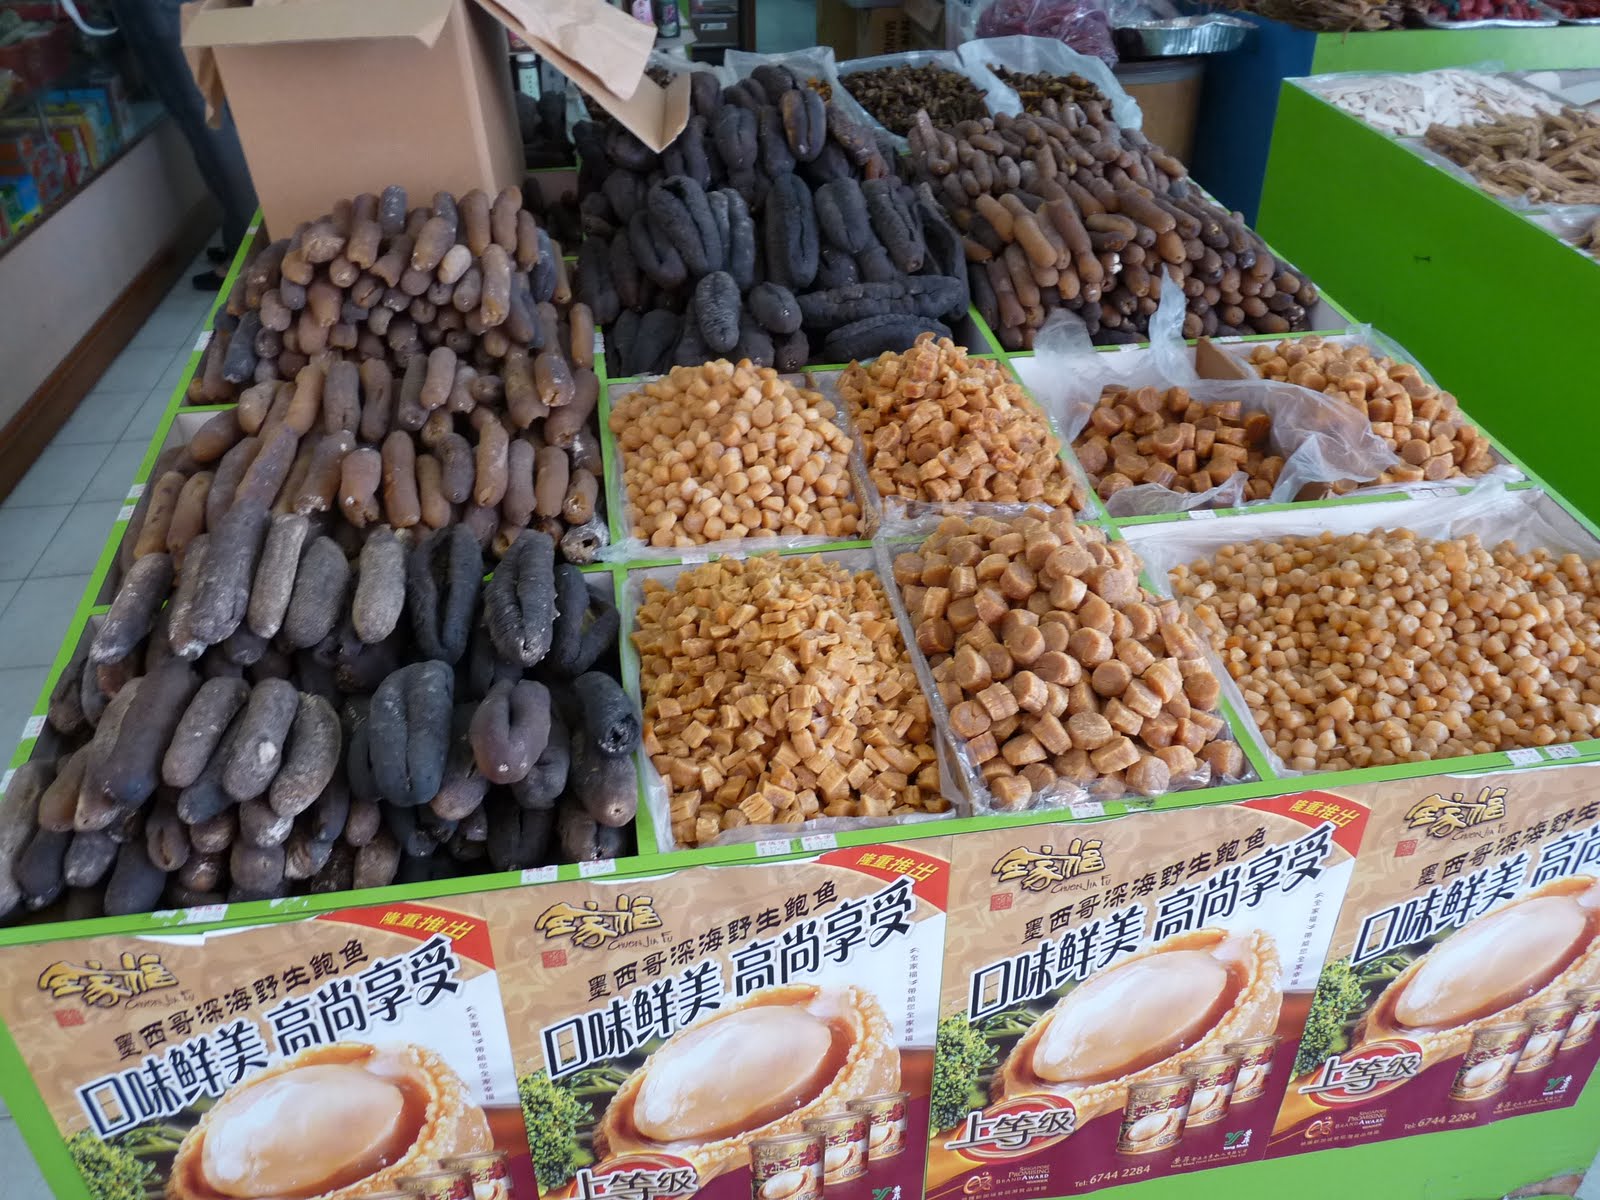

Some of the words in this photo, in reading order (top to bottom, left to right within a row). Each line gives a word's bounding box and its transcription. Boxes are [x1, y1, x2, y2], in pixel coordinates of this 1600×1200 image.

[1288, 799, 1361, 828] 隆重推出
[1404, 786, 1508, 838] 全家福
[856, 853, 940, 881] 隆重推出
[991, 838, 1106, 892] 全家福
[1021, 826, 1268, 945] 墨西哥深海野生鲍鱼
[379, 911, 476, 941] 隆重推出
[534, 893, 663, 948] 全家福
[971, 907, 1146, 1020] 口味鲜美
[1154, 823, 1334, 942] 高尚享受
[1349, 854, 1521, 964] 口味鲜美
[586, 879, 839, 1003] 墨西哥深海野生鲍鱼
[38, 951, 180, 1008] 全家福
[113, 938, 370, 1062] 墨西哥深海野生鲍鱼
[543, 962, 722, 1078] 口味鲜美
[730, 878, 915, 998] 高尚享受
[80, 1021, 271, 1138] 口味鲜美
[268, 936, 462, 1058] 高尚享受
[1298, 1050, 1423, 1096] 上等级
[945, 1106, 1076, 1151] 上等级
[1417, 1115, 1446, 1127] 6744
[1448, 1111, 1477, 1123] 2284
[1089, 1171, 1118, 1184] 6744
[1121, 1164, 1150, 1178] 2284
